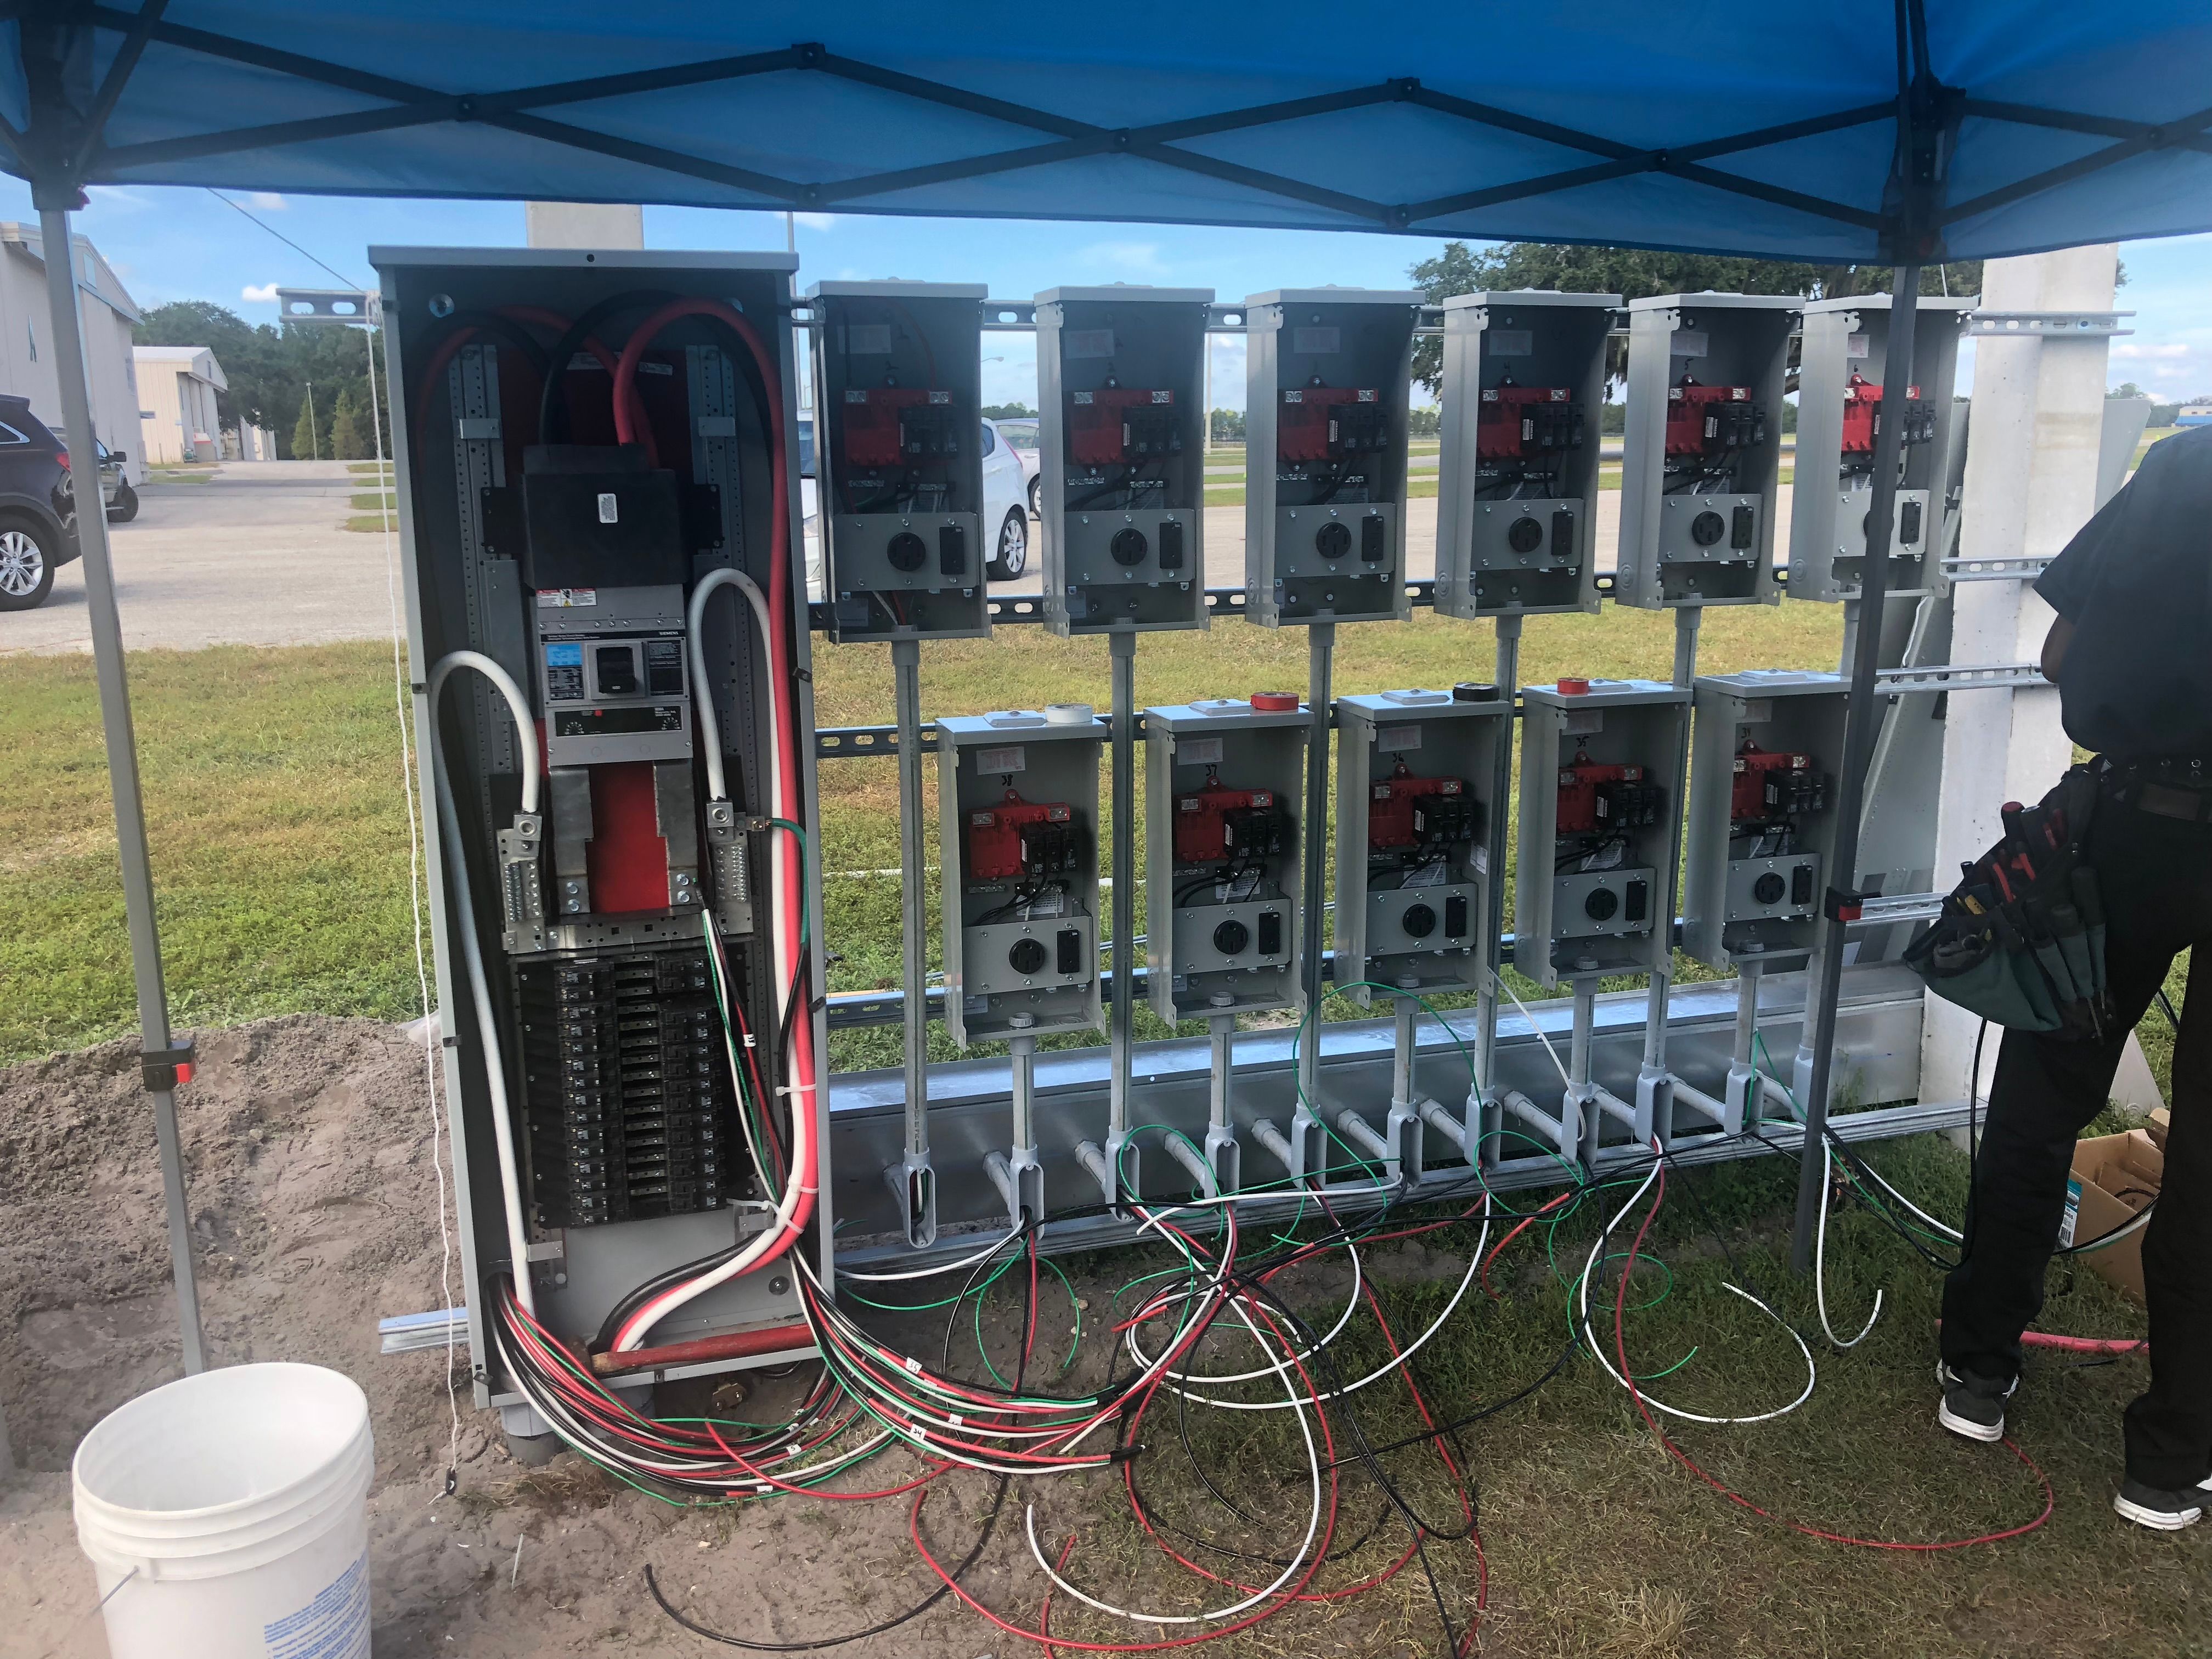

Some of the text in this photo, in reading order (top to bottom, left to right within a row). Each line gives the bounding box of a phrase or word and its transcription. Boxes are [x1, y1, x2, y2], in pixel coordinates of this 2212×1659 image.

[1684, 358, 1694, 370] 5
[1854, 364, 1858, 373] 6
[1576, 736, 1589, 747] 35
[1392, 753, 1404, 763] 36
[1205, 764, 1217, 776] 37
[1001, 774, 1013, 786] 38
[909, 1361, 919, 1372] 35
[913, 1428, 923, 1438] 34
